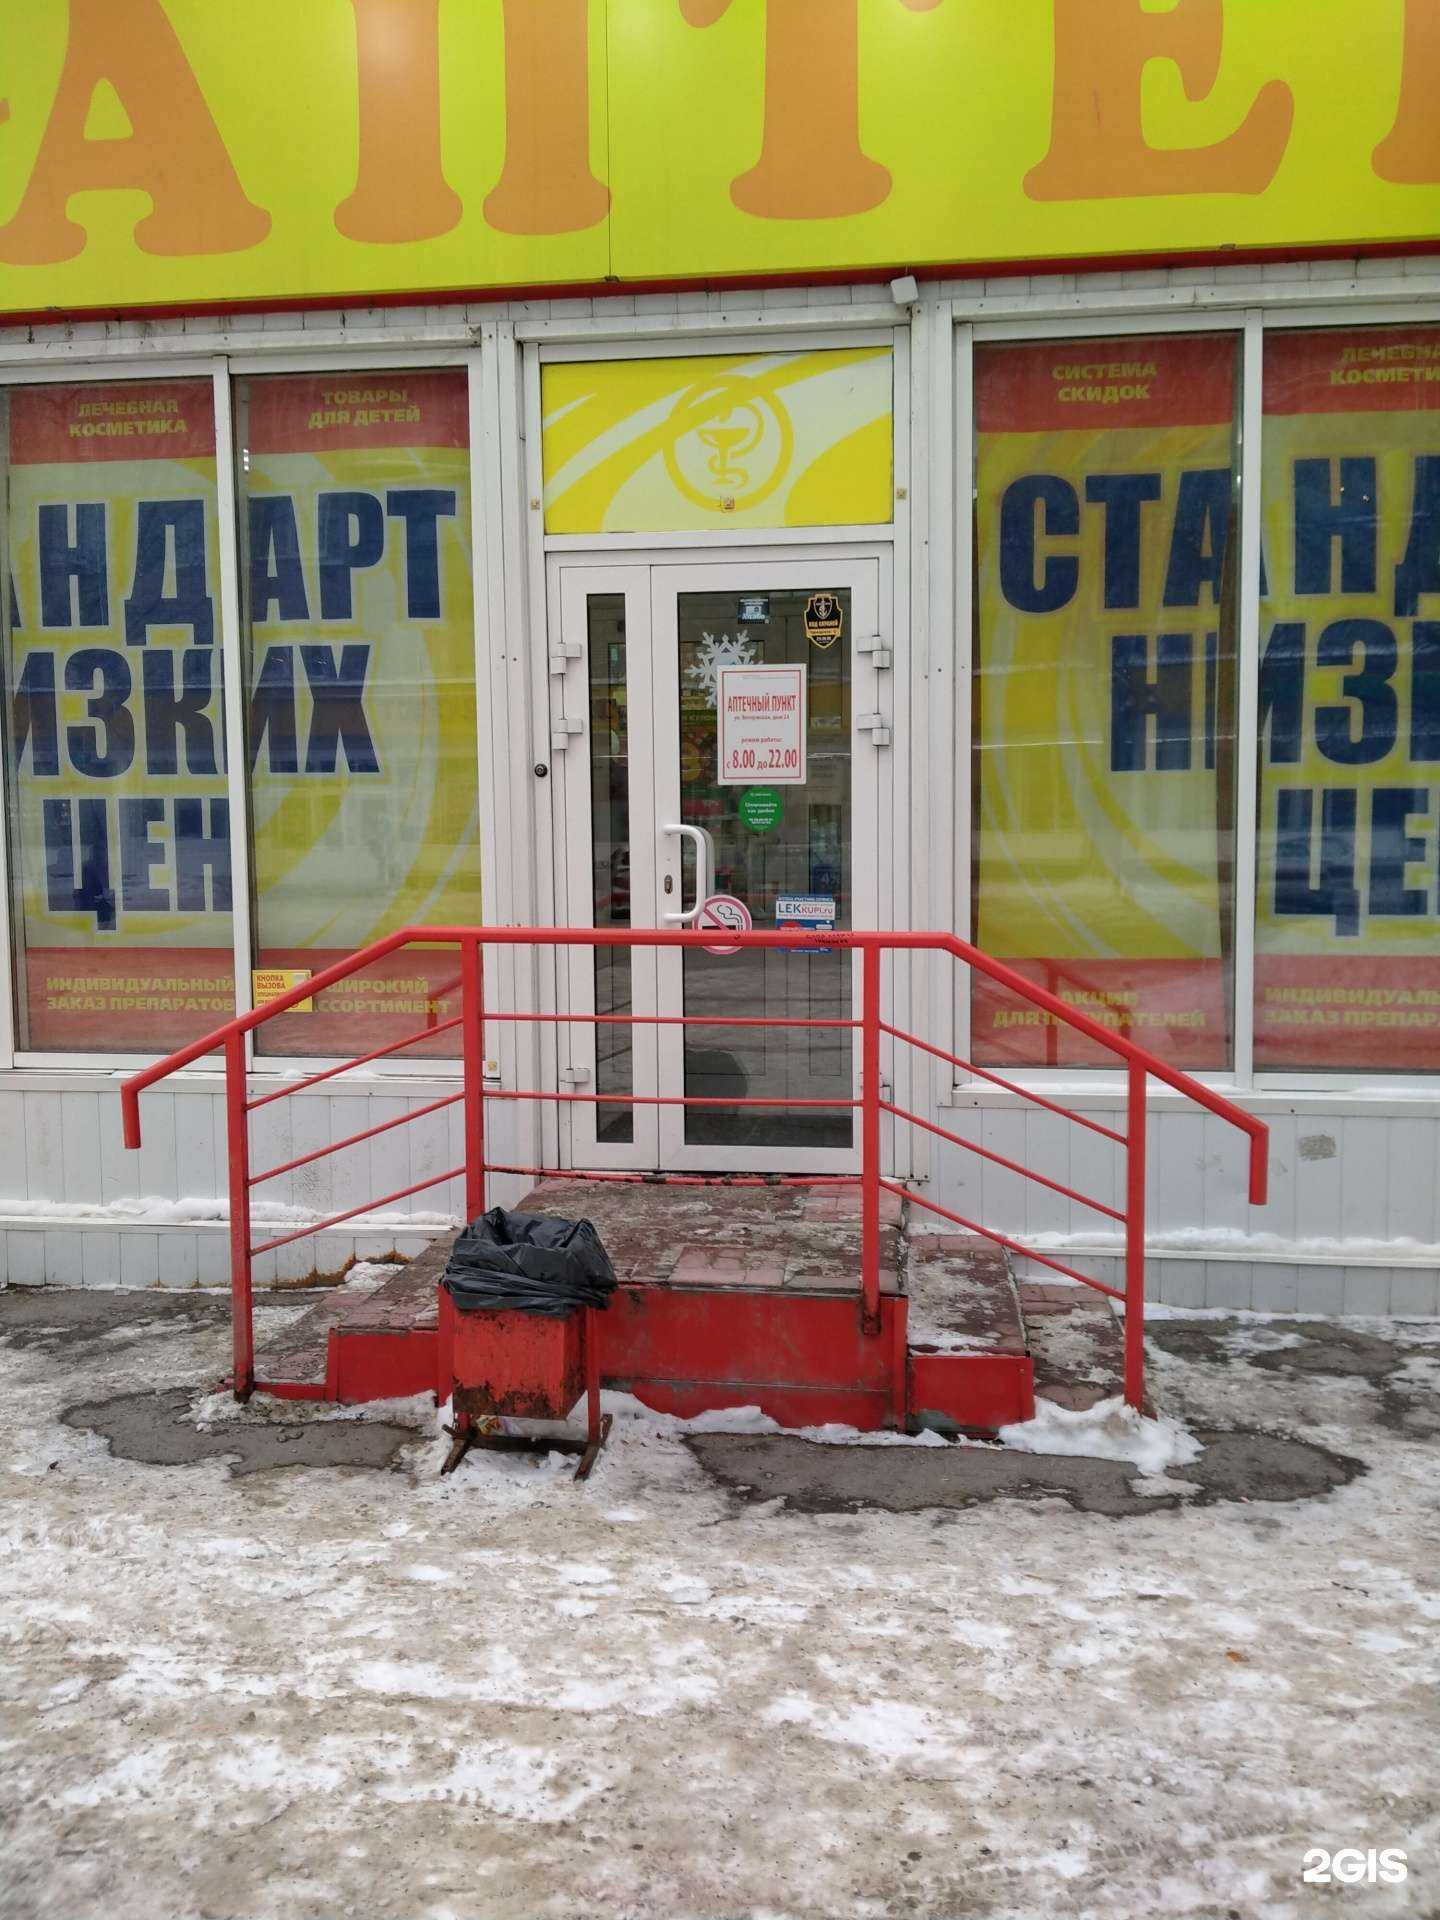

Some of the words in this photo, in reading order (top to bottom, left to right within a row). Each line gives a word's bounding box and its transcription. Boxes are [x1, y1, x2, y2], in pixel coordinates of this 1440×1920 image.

[1052, 362, 1158, 380] СИСТЕМА
[321, 389, 408, 405] ТОВАРЫ
[1058, 384, 1151, 404] СКИДОК
[79, 399, 179, 416] ЛЕЧЕБНАЯ
[308, 410, 350, 429] ДЛЯ
[353, 405, 421, 426] ДЕТЕЙ
[69, 419, 187, 437] КОСМЕТИКА
[10, 489, 456, 646] НДАРТ
[727, 692, 770, 712] АПТЕЧНЫЙ
[772, 695, 796, 711] ПУНКТ
[732, 749, 755, 768] 8.00
[757, 761, 767, 770] до
[768, 749, 797, 768] 22.00
[43, 798, 233, 930] ЦЕН
[1275, 788, 1440, 936] ЦЕ
[47, 976, 235, 993] ИНДИВИДУАЛЬНЫЙ
[48, 998, 106, 1010] ЗАКАЗ
[110, 998, 234, 1011] ПРЕПАРАТОВ
[314, 1000, 450, 1013] ССОРТИМЕНТ
[992, 1011, 1041, 1028] ДЛЯ
[1264, 1009, 1340, 1024] ЗАКАЗ
